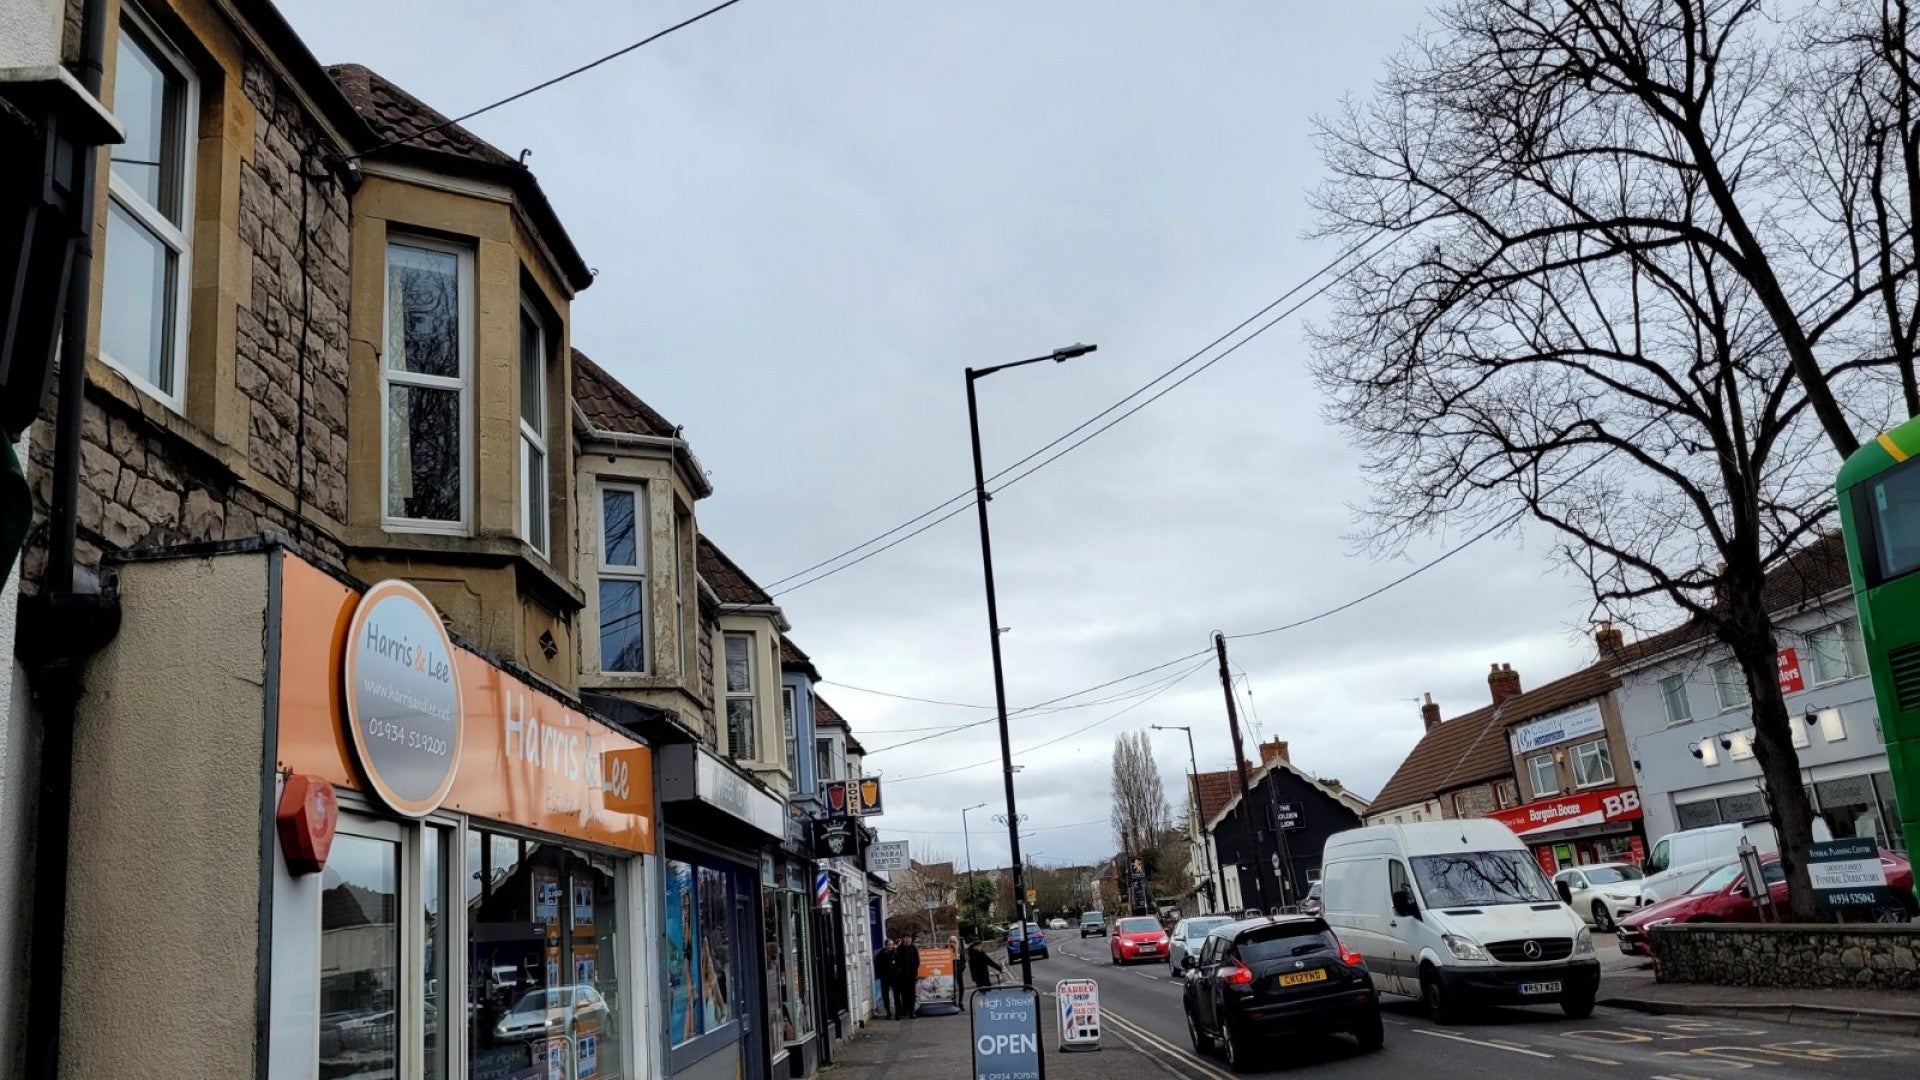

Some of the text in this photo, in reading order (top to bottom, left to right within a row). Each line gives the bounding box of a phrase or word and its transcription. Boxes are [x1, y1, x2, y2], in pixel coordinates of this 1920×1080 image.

[366, 621, 450, 684] Harris & Lee
[369, 717, 447, 757] 01934 519200
[505, 689, 579, 781] Harris
[600, 740, 629, 800] Lee
[848, 782, 861, 815] DONER
[1529, 805, 1557, 823] Bargain
[1557, 803, 1580, 817] Booze
[1602, 790, 1640, 818] BB
[1277, 811, 1298, 820] OLDEN
[871, 850, 904, 859] FUNERAL
[1061, 985, 1094, 995] BARBER
[979, 995, 1035, 1010] High Street
[990, 1010, 1027, 1022] Tanning
[977, 1033, 1037, 1056] OPEN
